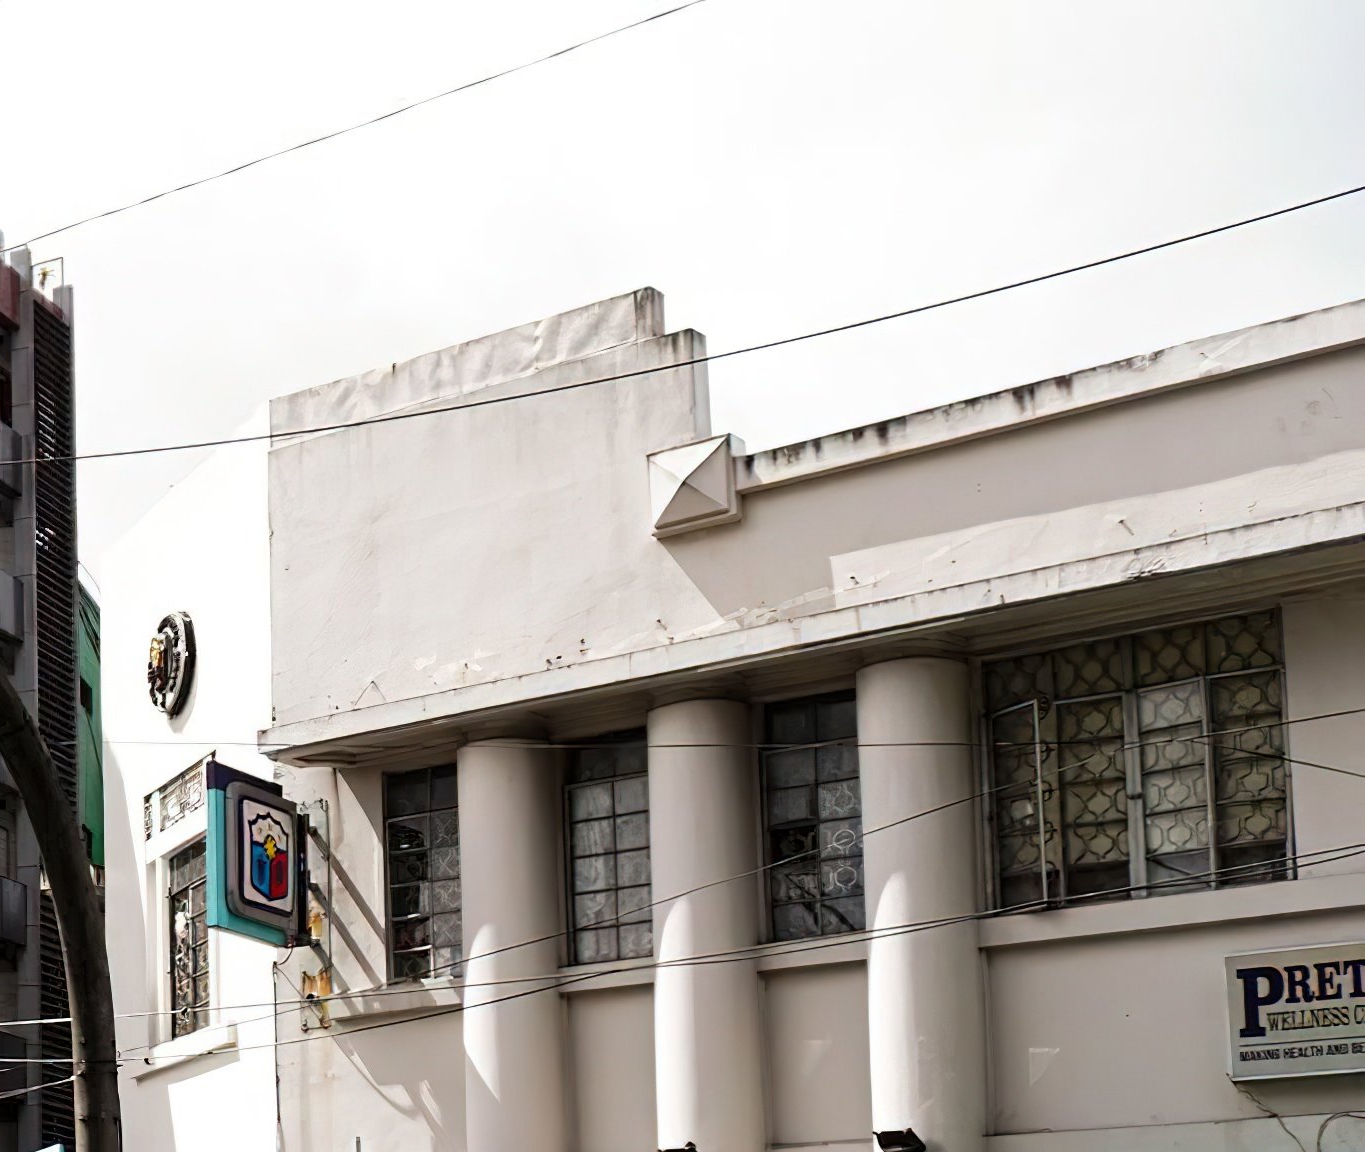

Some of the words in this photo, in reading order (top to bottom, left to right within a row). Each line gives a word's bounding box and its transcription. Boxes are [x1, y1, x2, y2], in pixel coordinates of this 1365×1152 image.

[1267, 1006, 1350, 1031] WELLNESS
[1283, 1045, 1324, 1060] HEALTH
[1326, 1043, 1349, 1056] AND
